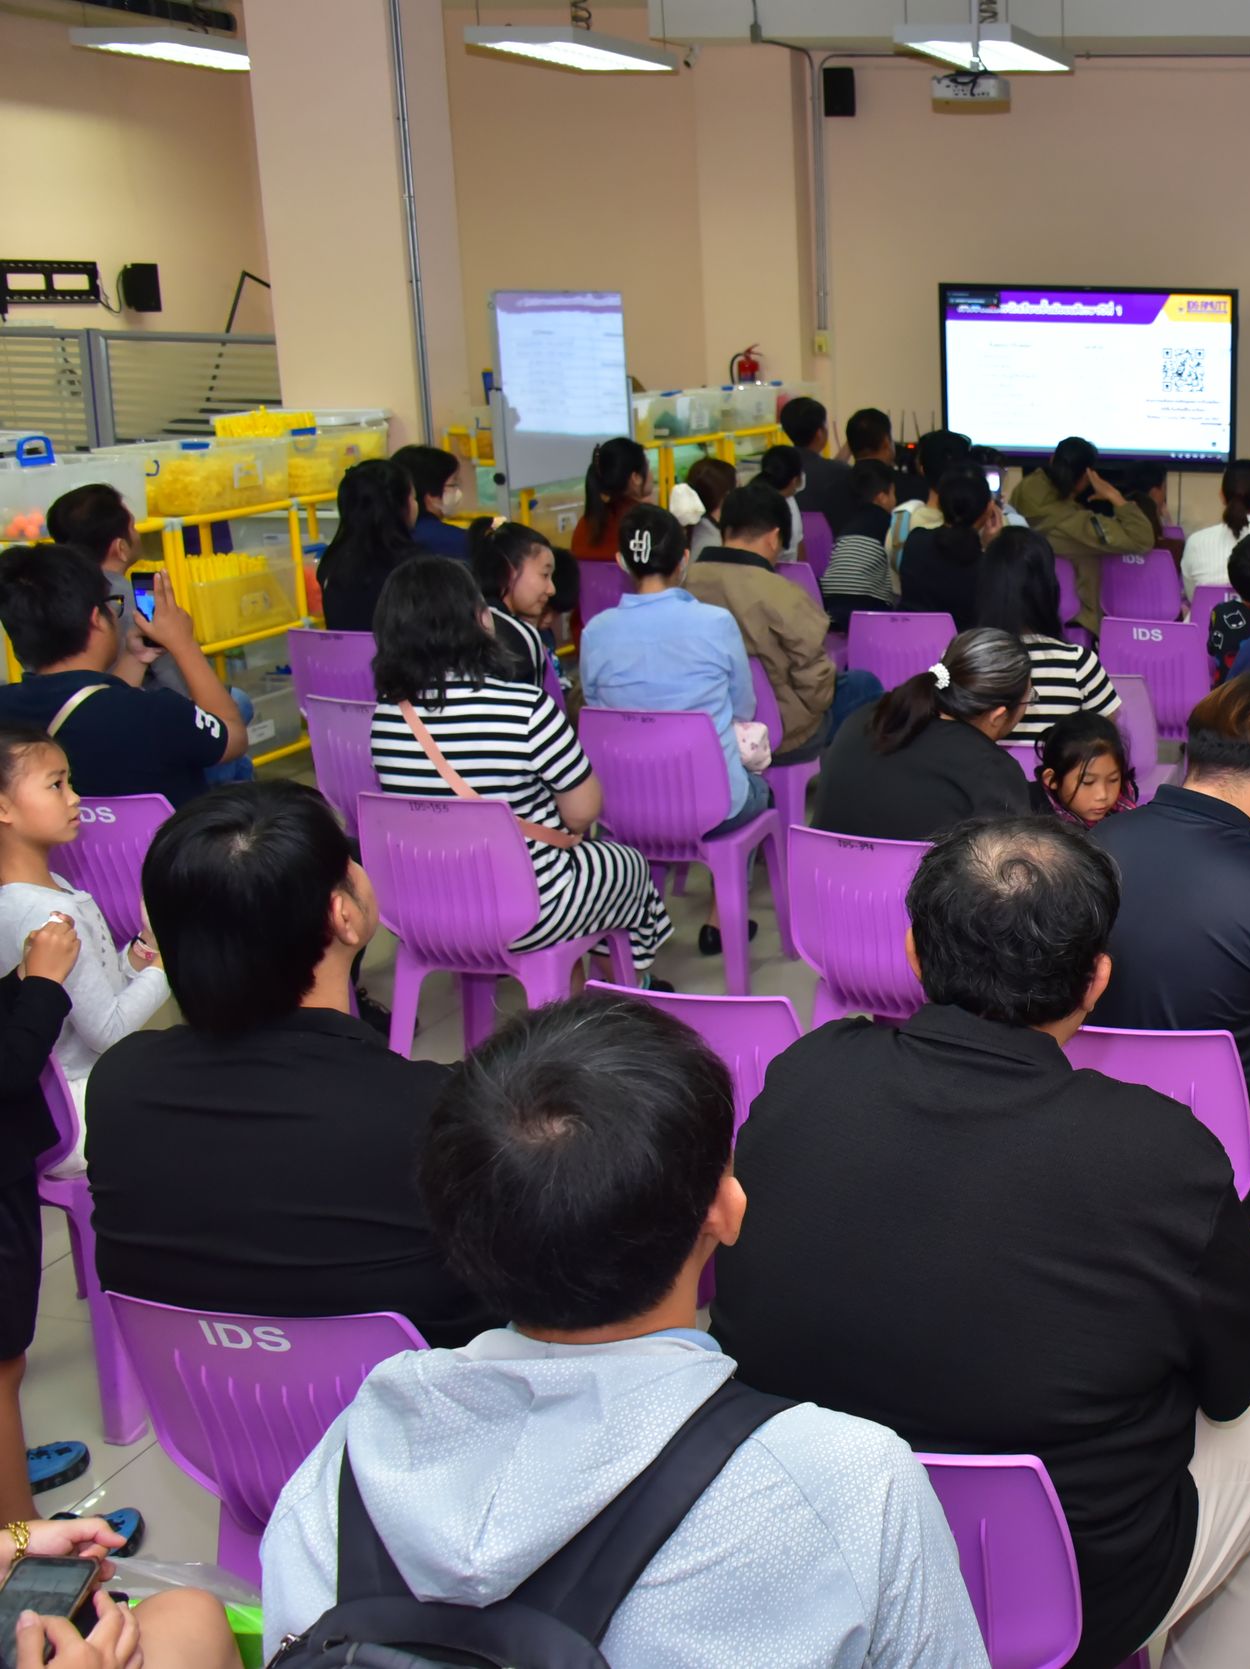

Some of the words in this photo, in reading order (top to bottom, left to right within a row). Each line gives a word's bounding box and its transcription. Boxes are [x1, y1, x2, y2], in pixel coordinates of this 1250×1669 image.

[1122, 554, 1145, 565] IDS
[1223, 592, 1243, 603] ID
[1132, 627, 1163, 641] IDS
[78, 806, 116, 823] DS
[197, 1319, 292, 1352] IDS
